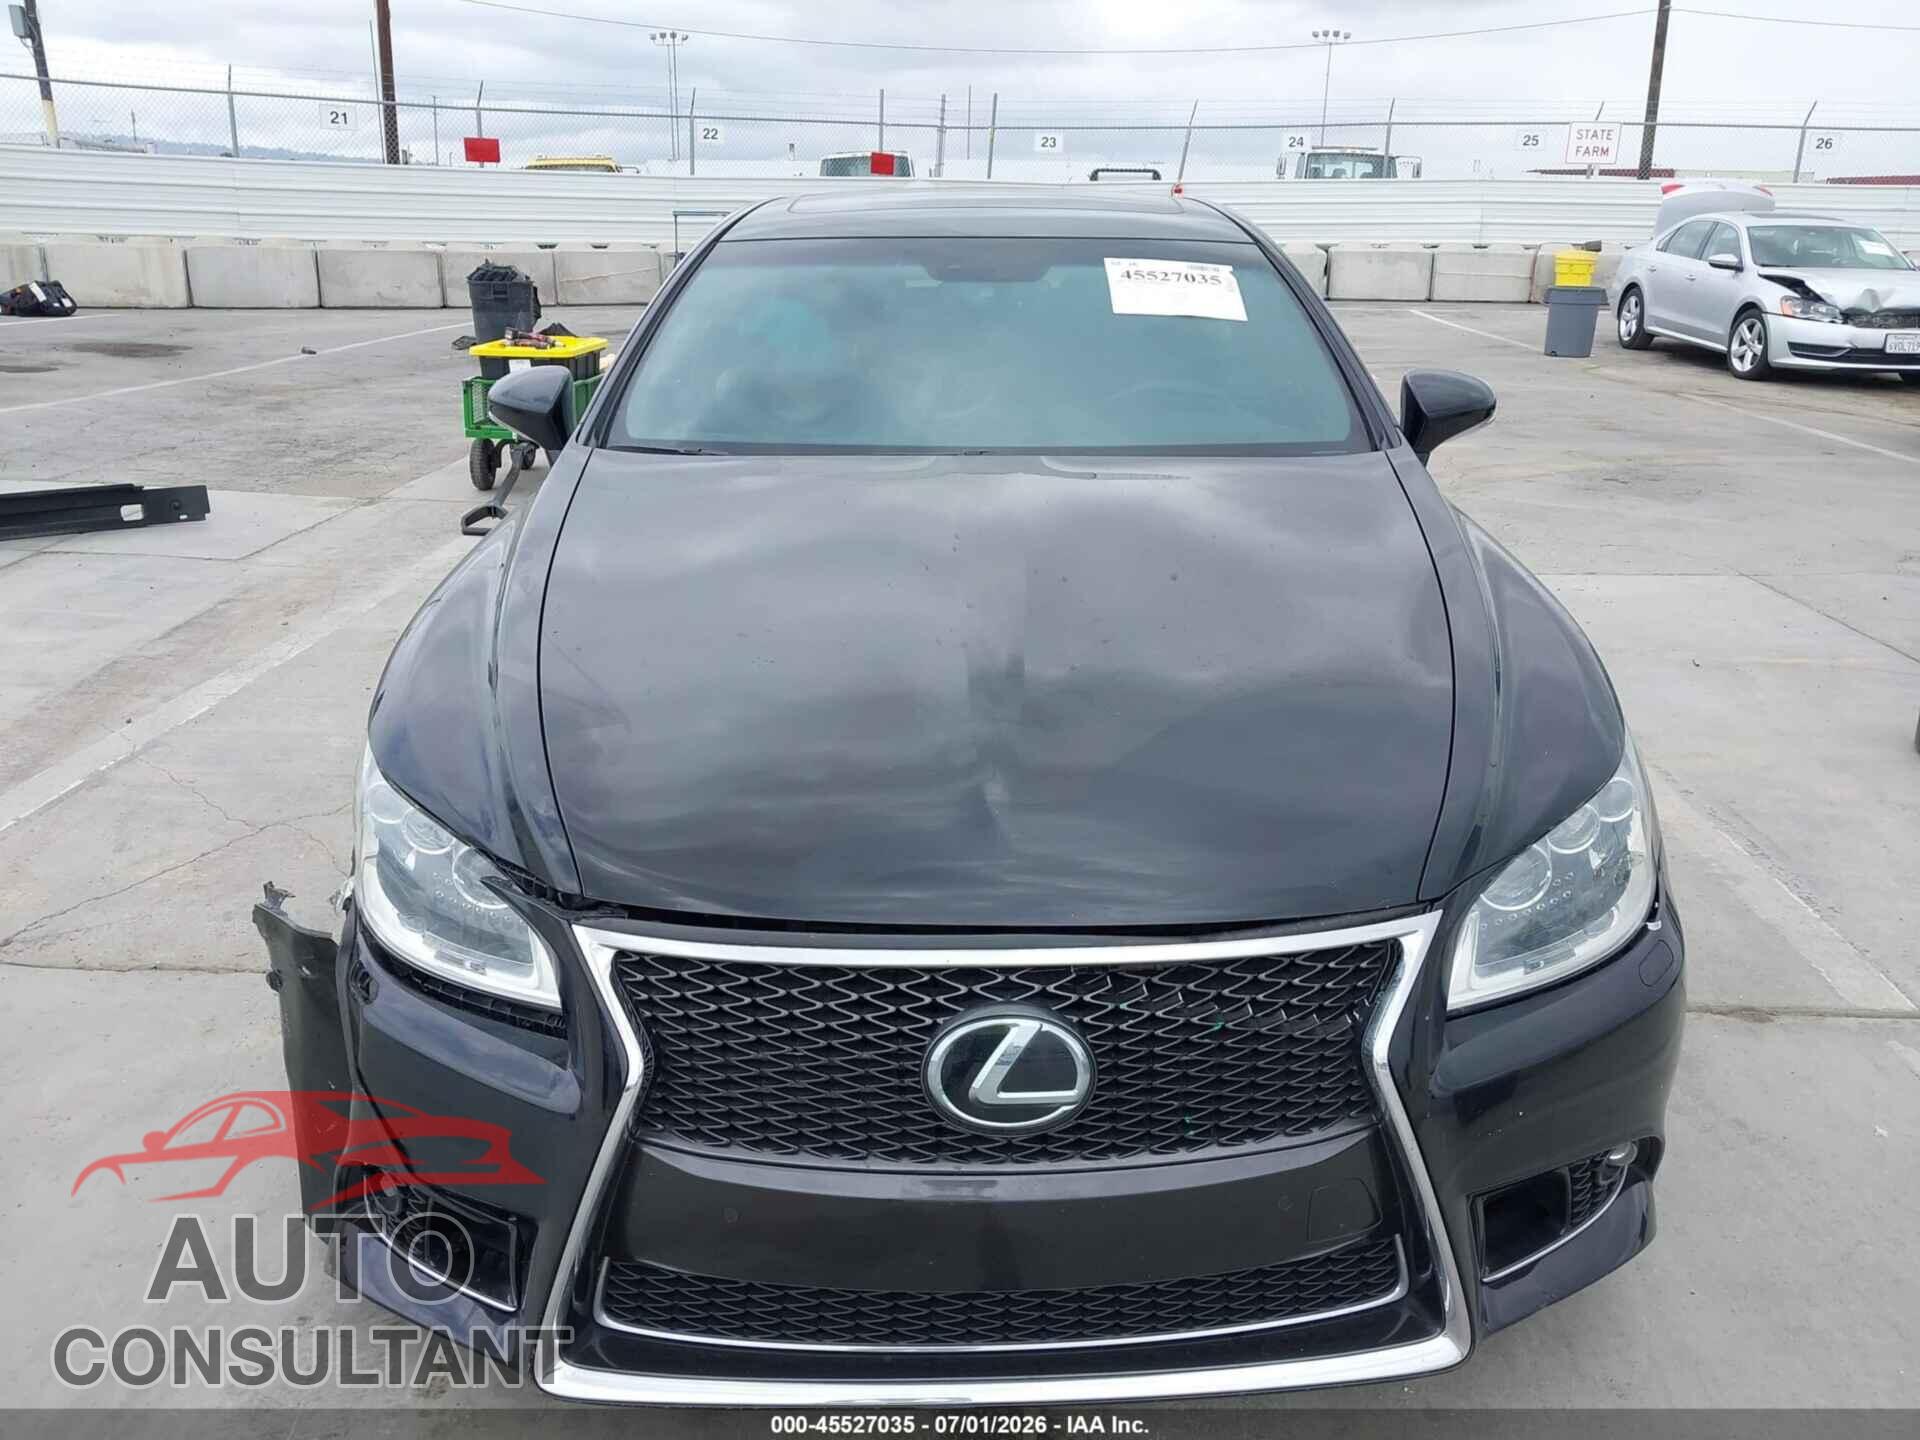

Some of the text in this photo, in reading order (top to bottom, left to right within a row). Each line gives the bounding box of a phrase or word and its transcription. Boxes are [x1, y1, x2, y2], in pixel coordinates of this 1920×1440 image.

[329, 110, 348, 125] 21
[703, 127, 719, 140] 22
[1576, 128, 1614, 141] STATE
[1040, 136, 1057, 148] 23
[1288, 136, 1304, 148] 24
[1522, 134, 1539, 147] 25
[1815, 137, 1833, 150] 26
[1574, 145, 1610, 157] FARM
[1121, 269, 1222, 286] 45527035
